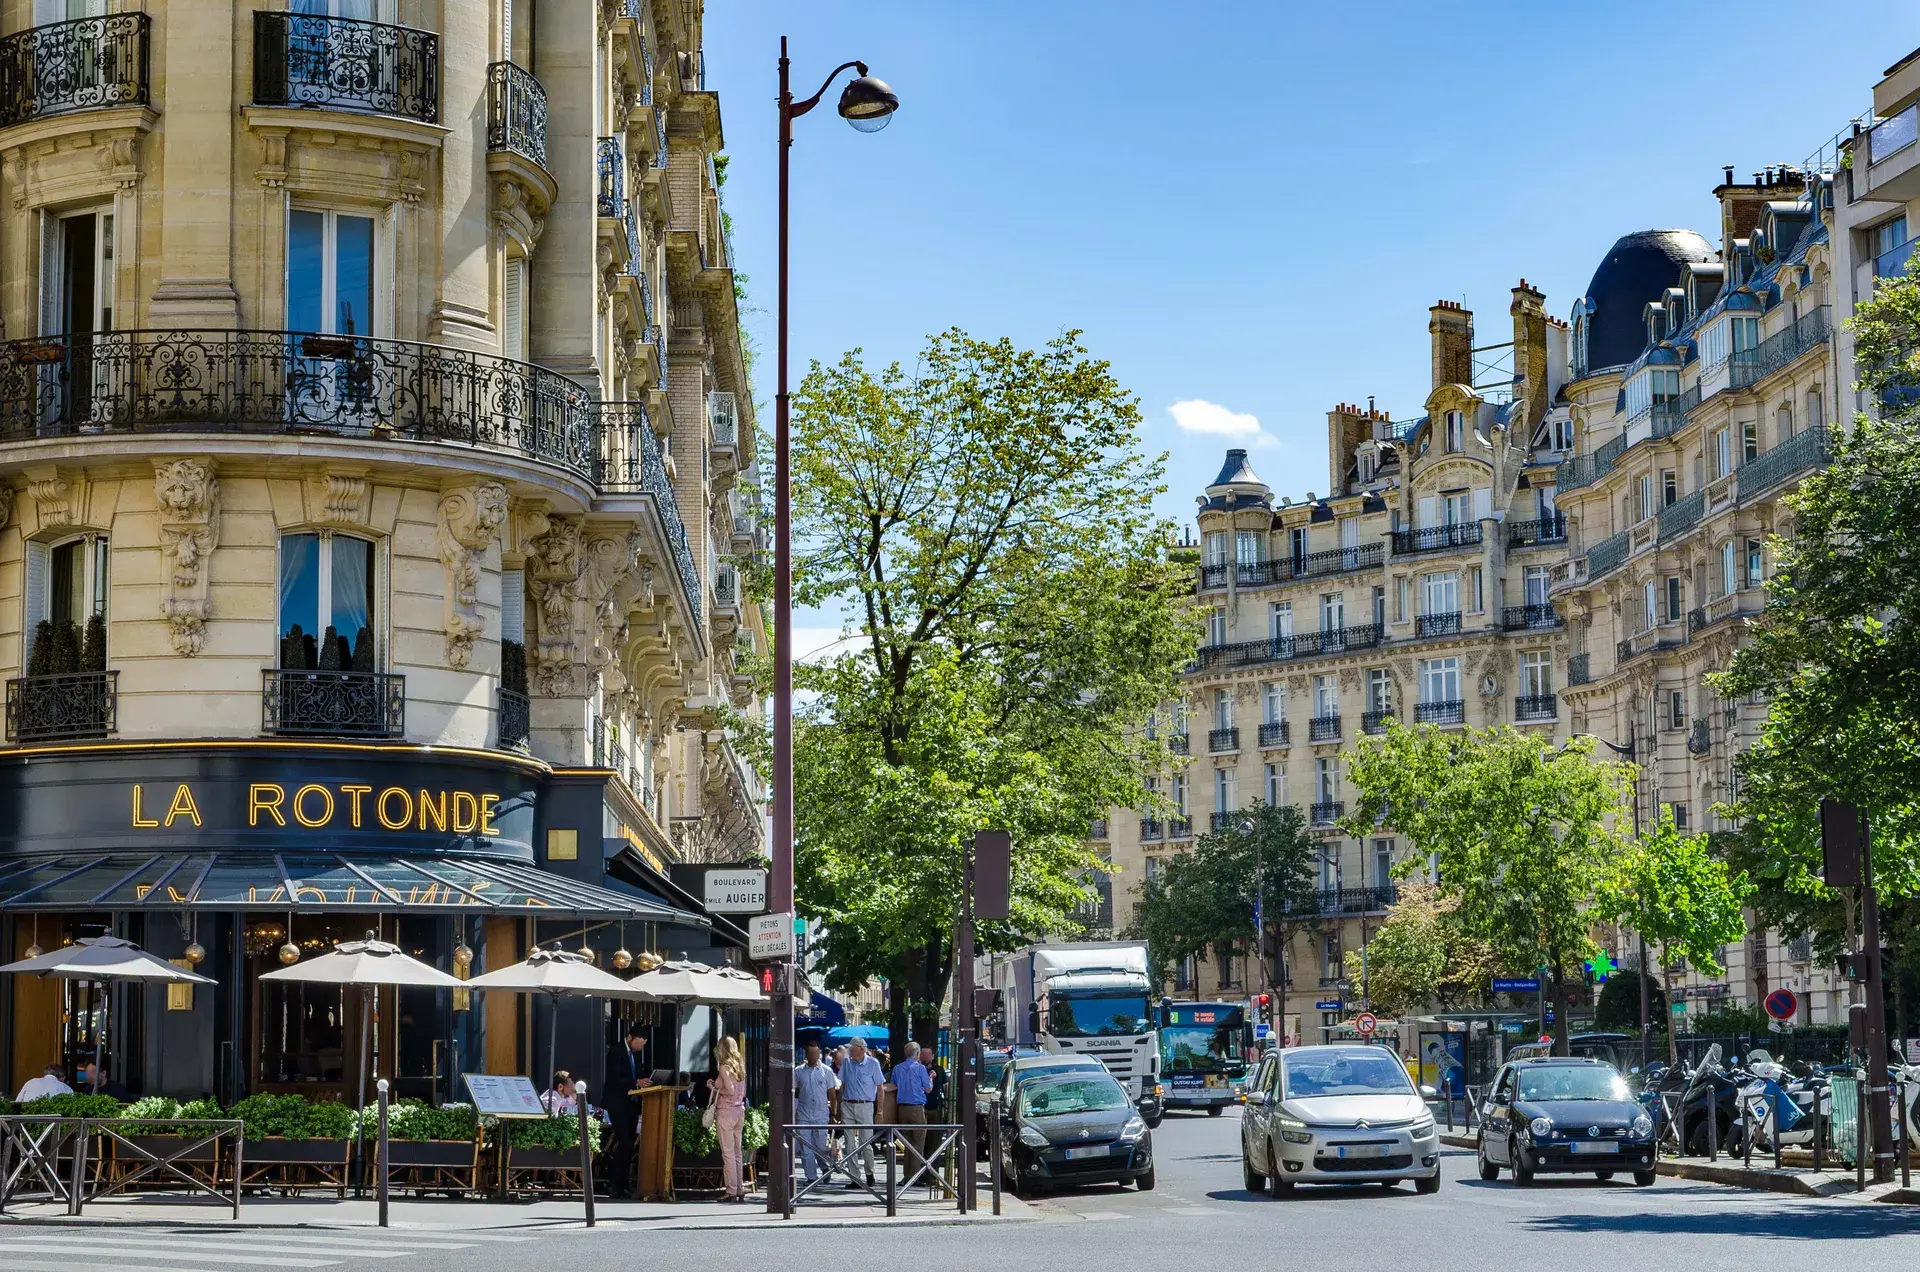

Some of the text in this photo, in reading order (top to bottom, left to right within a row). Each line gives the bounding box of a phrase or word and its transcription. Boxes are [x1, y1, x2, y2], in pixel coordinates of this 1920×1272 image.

[132, 783, 501, 836] LA ROTONDE
[726, 893, 764, 903] AUGIER
[760, 920, 779, 929] PIÉTONS
[757, 931, 782, 941] ATTENTION
[753, 941, 787, 954] FEUX DÉCALÉS
